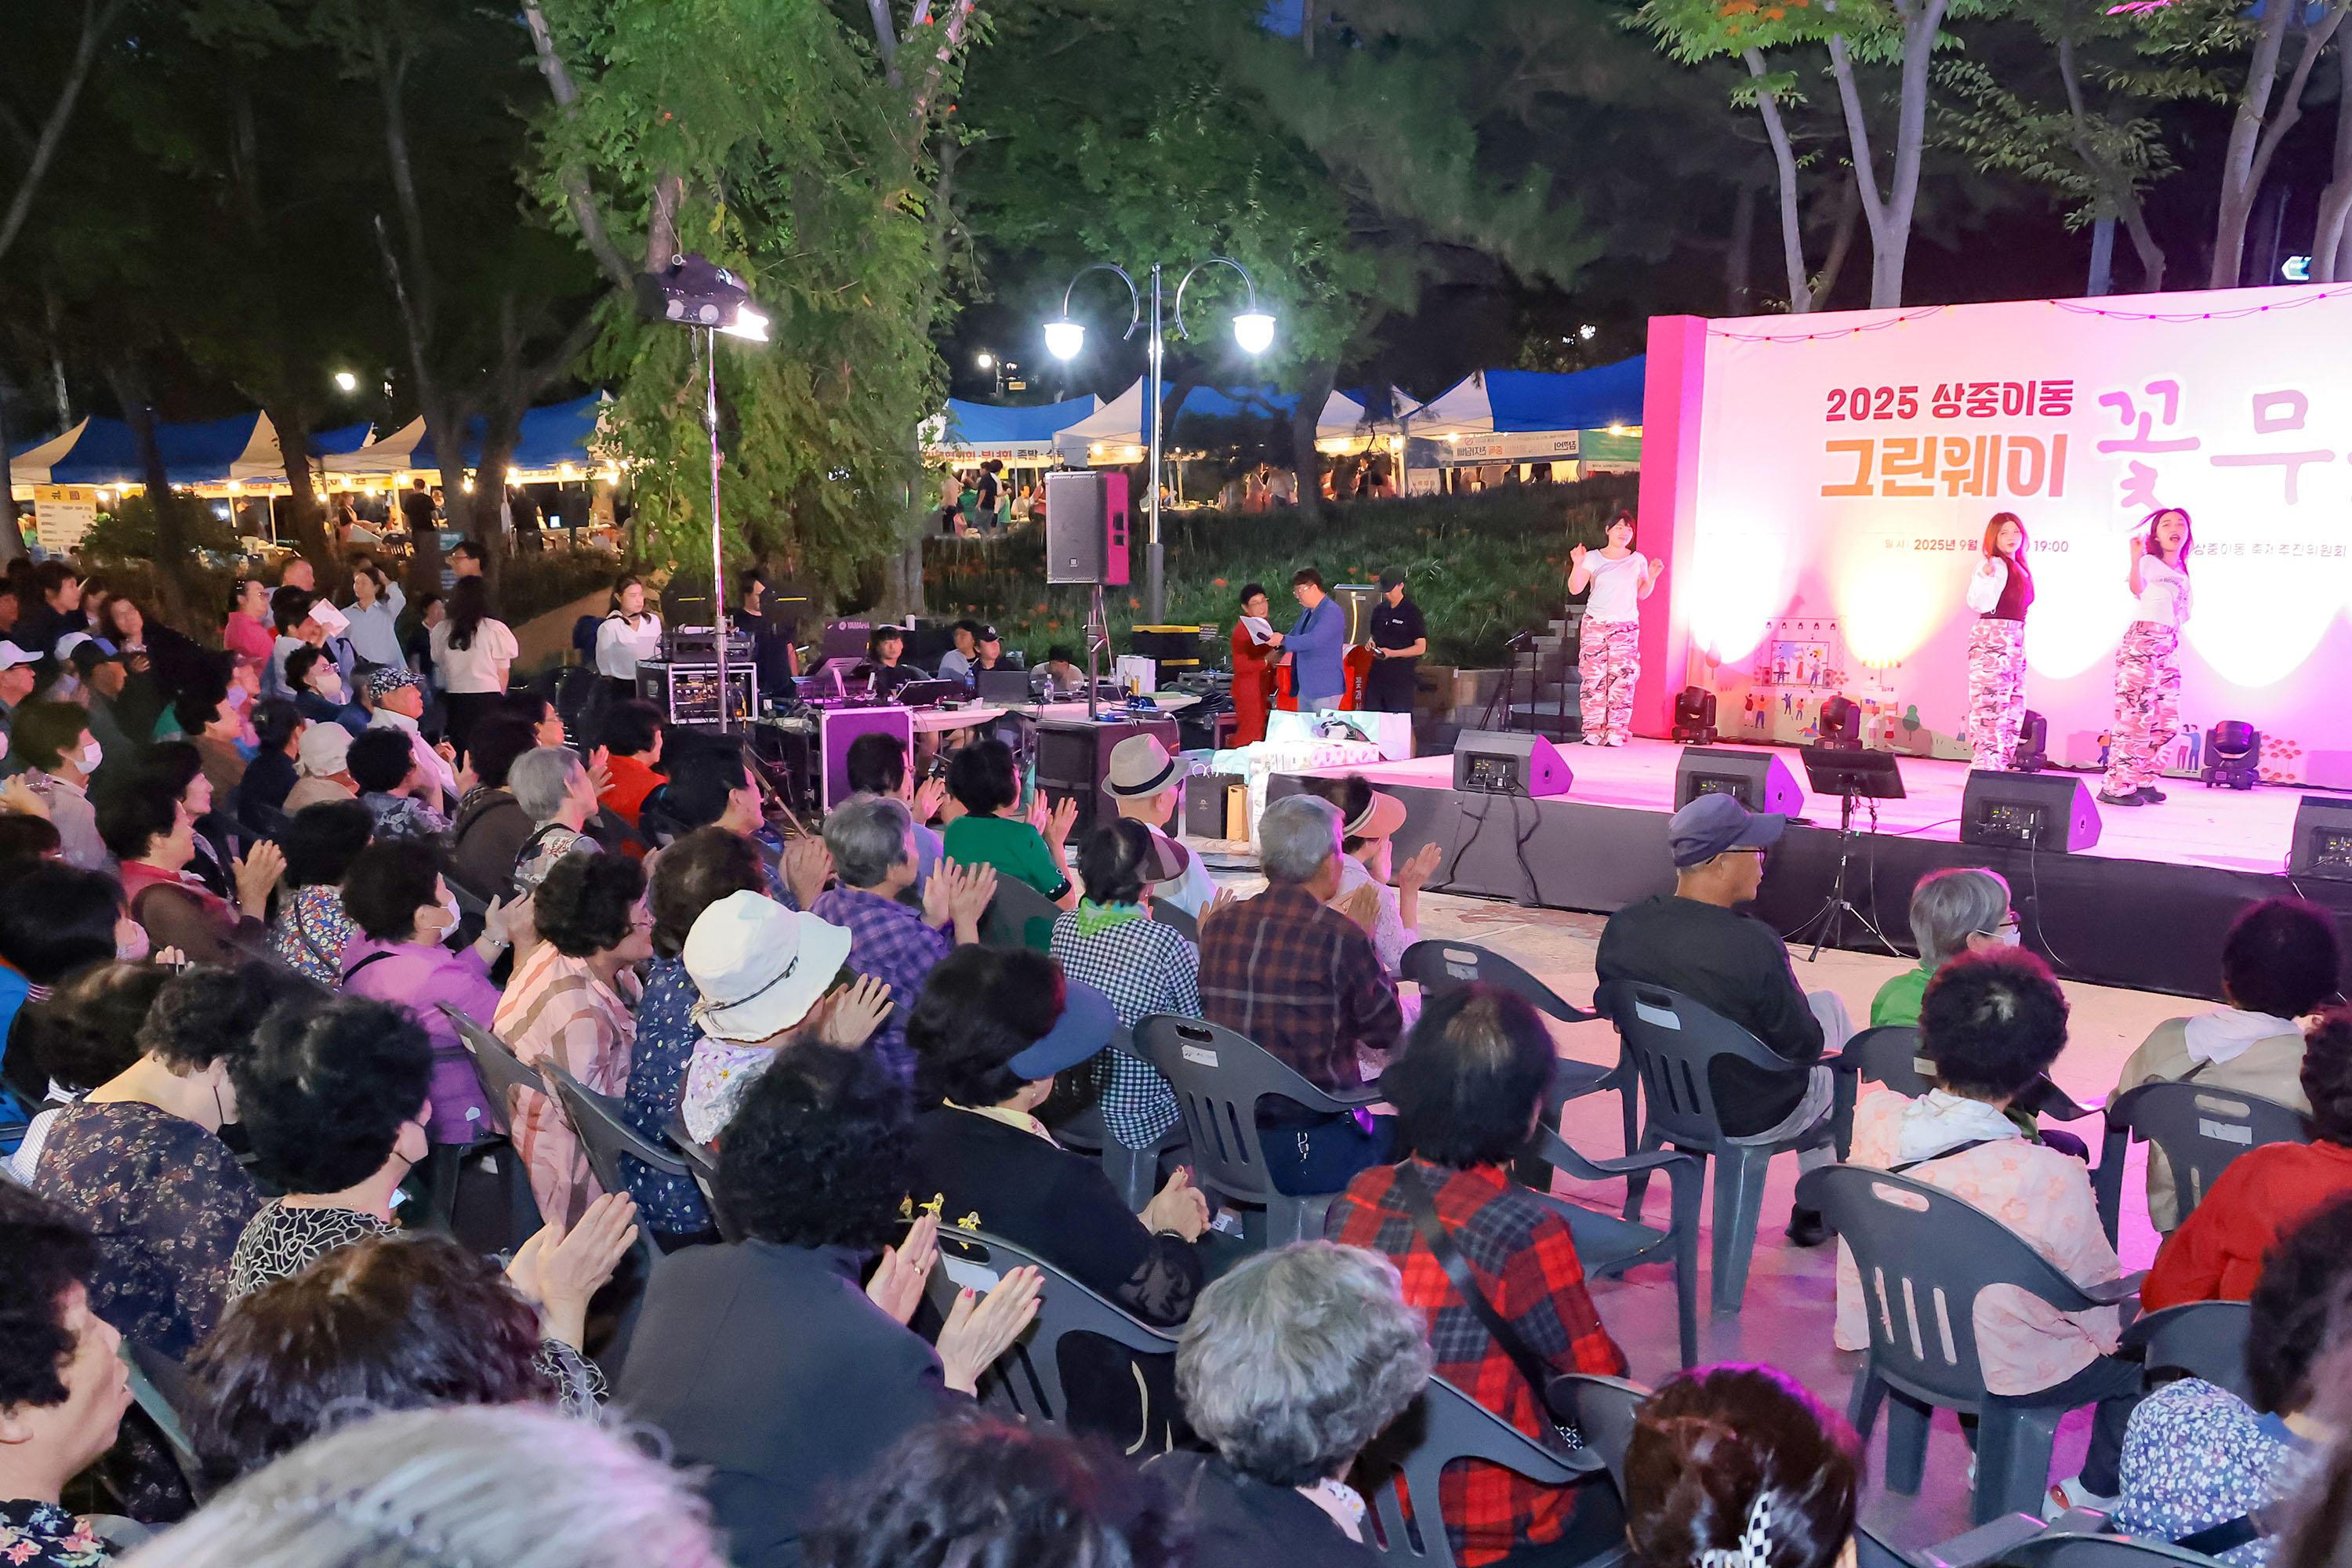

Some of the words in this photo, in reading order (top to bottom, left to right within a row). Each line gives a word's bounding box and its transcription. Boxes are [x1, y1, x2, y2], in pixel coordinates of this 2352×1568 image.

[1826, 386, 1918, 422] 2025
[1931, 379, 2074, 418] 상중이동
[1820, 434, 2065, 499] 그린웨이
[1914, 539, 1955, 551] 2025년
[1959, 539, 1978, 551] 9월
[2034, 540, 2068, 552] 19:00
[2194, 543, 2245, 556] 상중이동
[847, 621, 870, 630] YAMAHA
